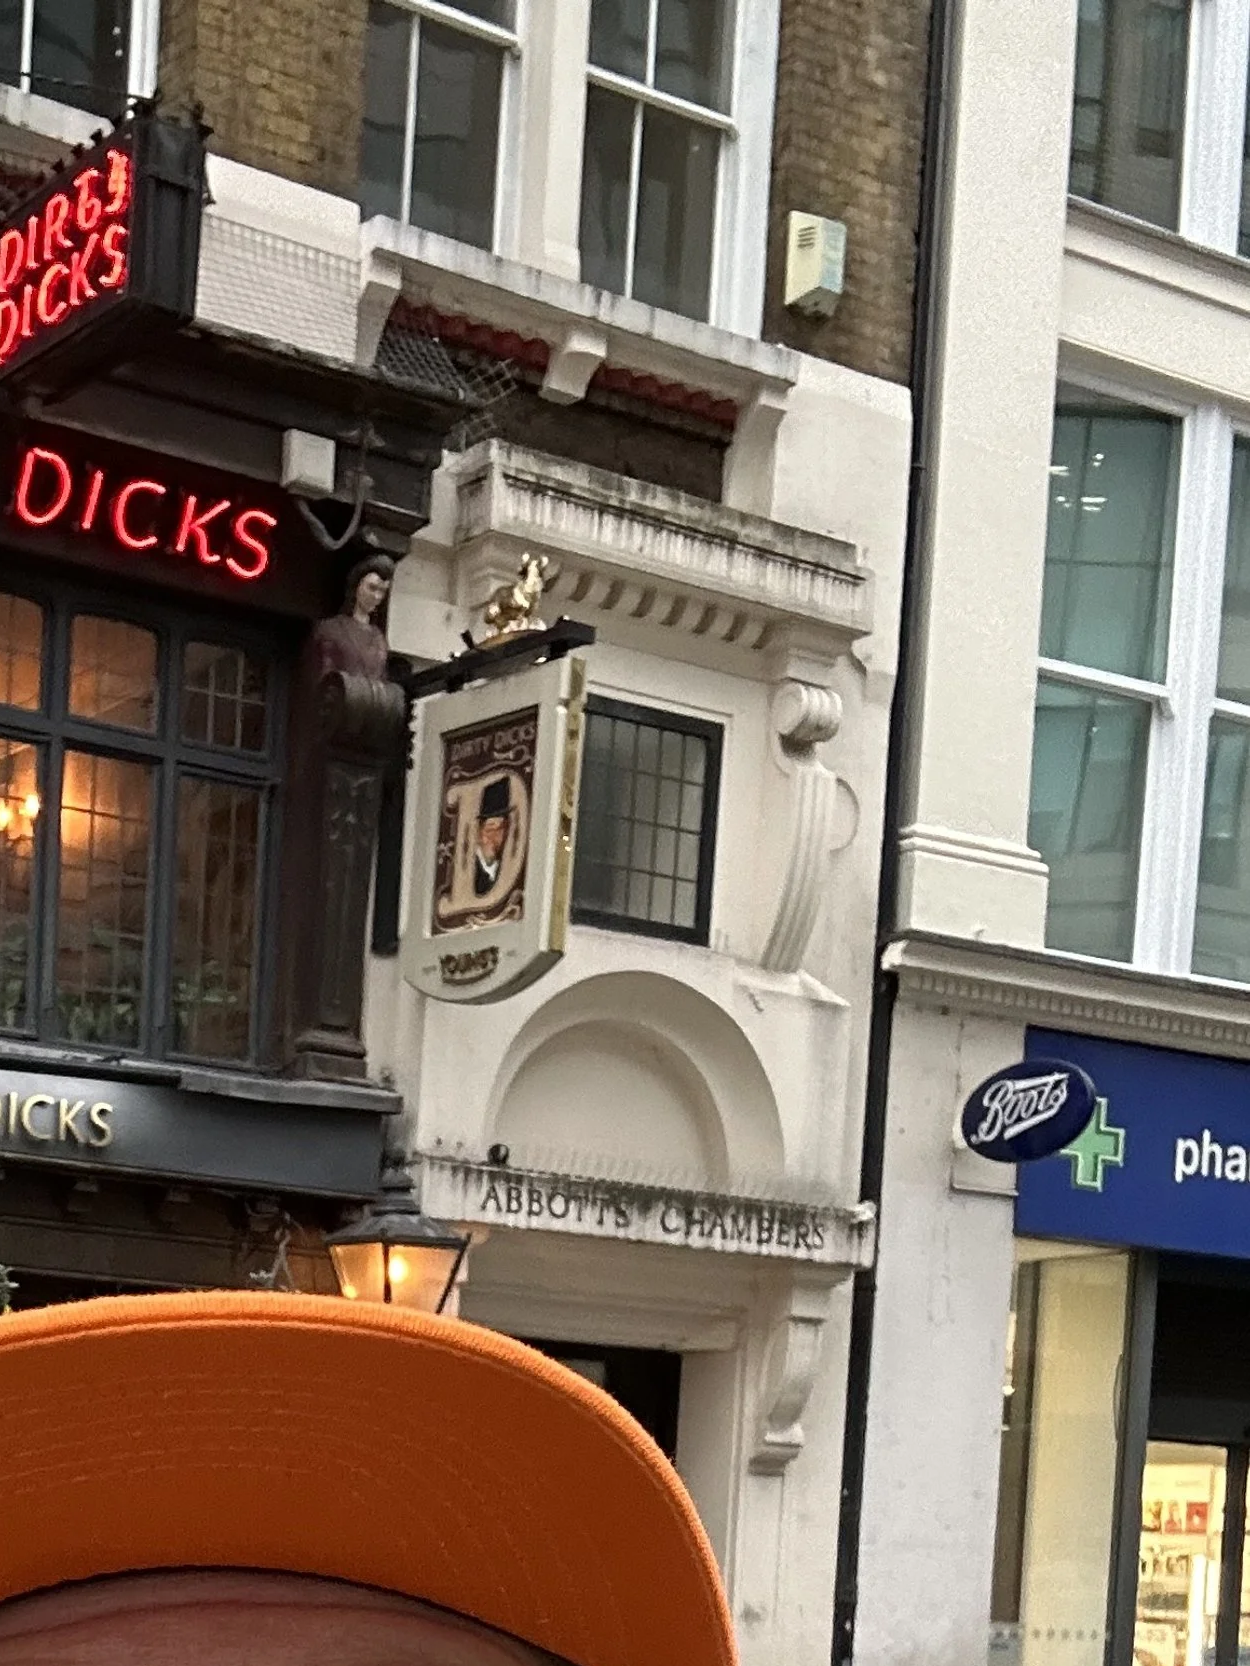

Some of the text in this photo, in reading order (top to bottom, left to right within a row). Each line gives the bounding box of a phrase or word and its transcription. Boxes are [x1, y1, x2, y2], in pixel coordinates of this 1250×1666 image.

[15, 446, 278, 579] DICKS
[970, 1072, 1070, 1144] Boots
[1174, 1128, 1250, 1184] pha
[480, 1183, 825, 1251] ABBOTTS CHAMBERS
